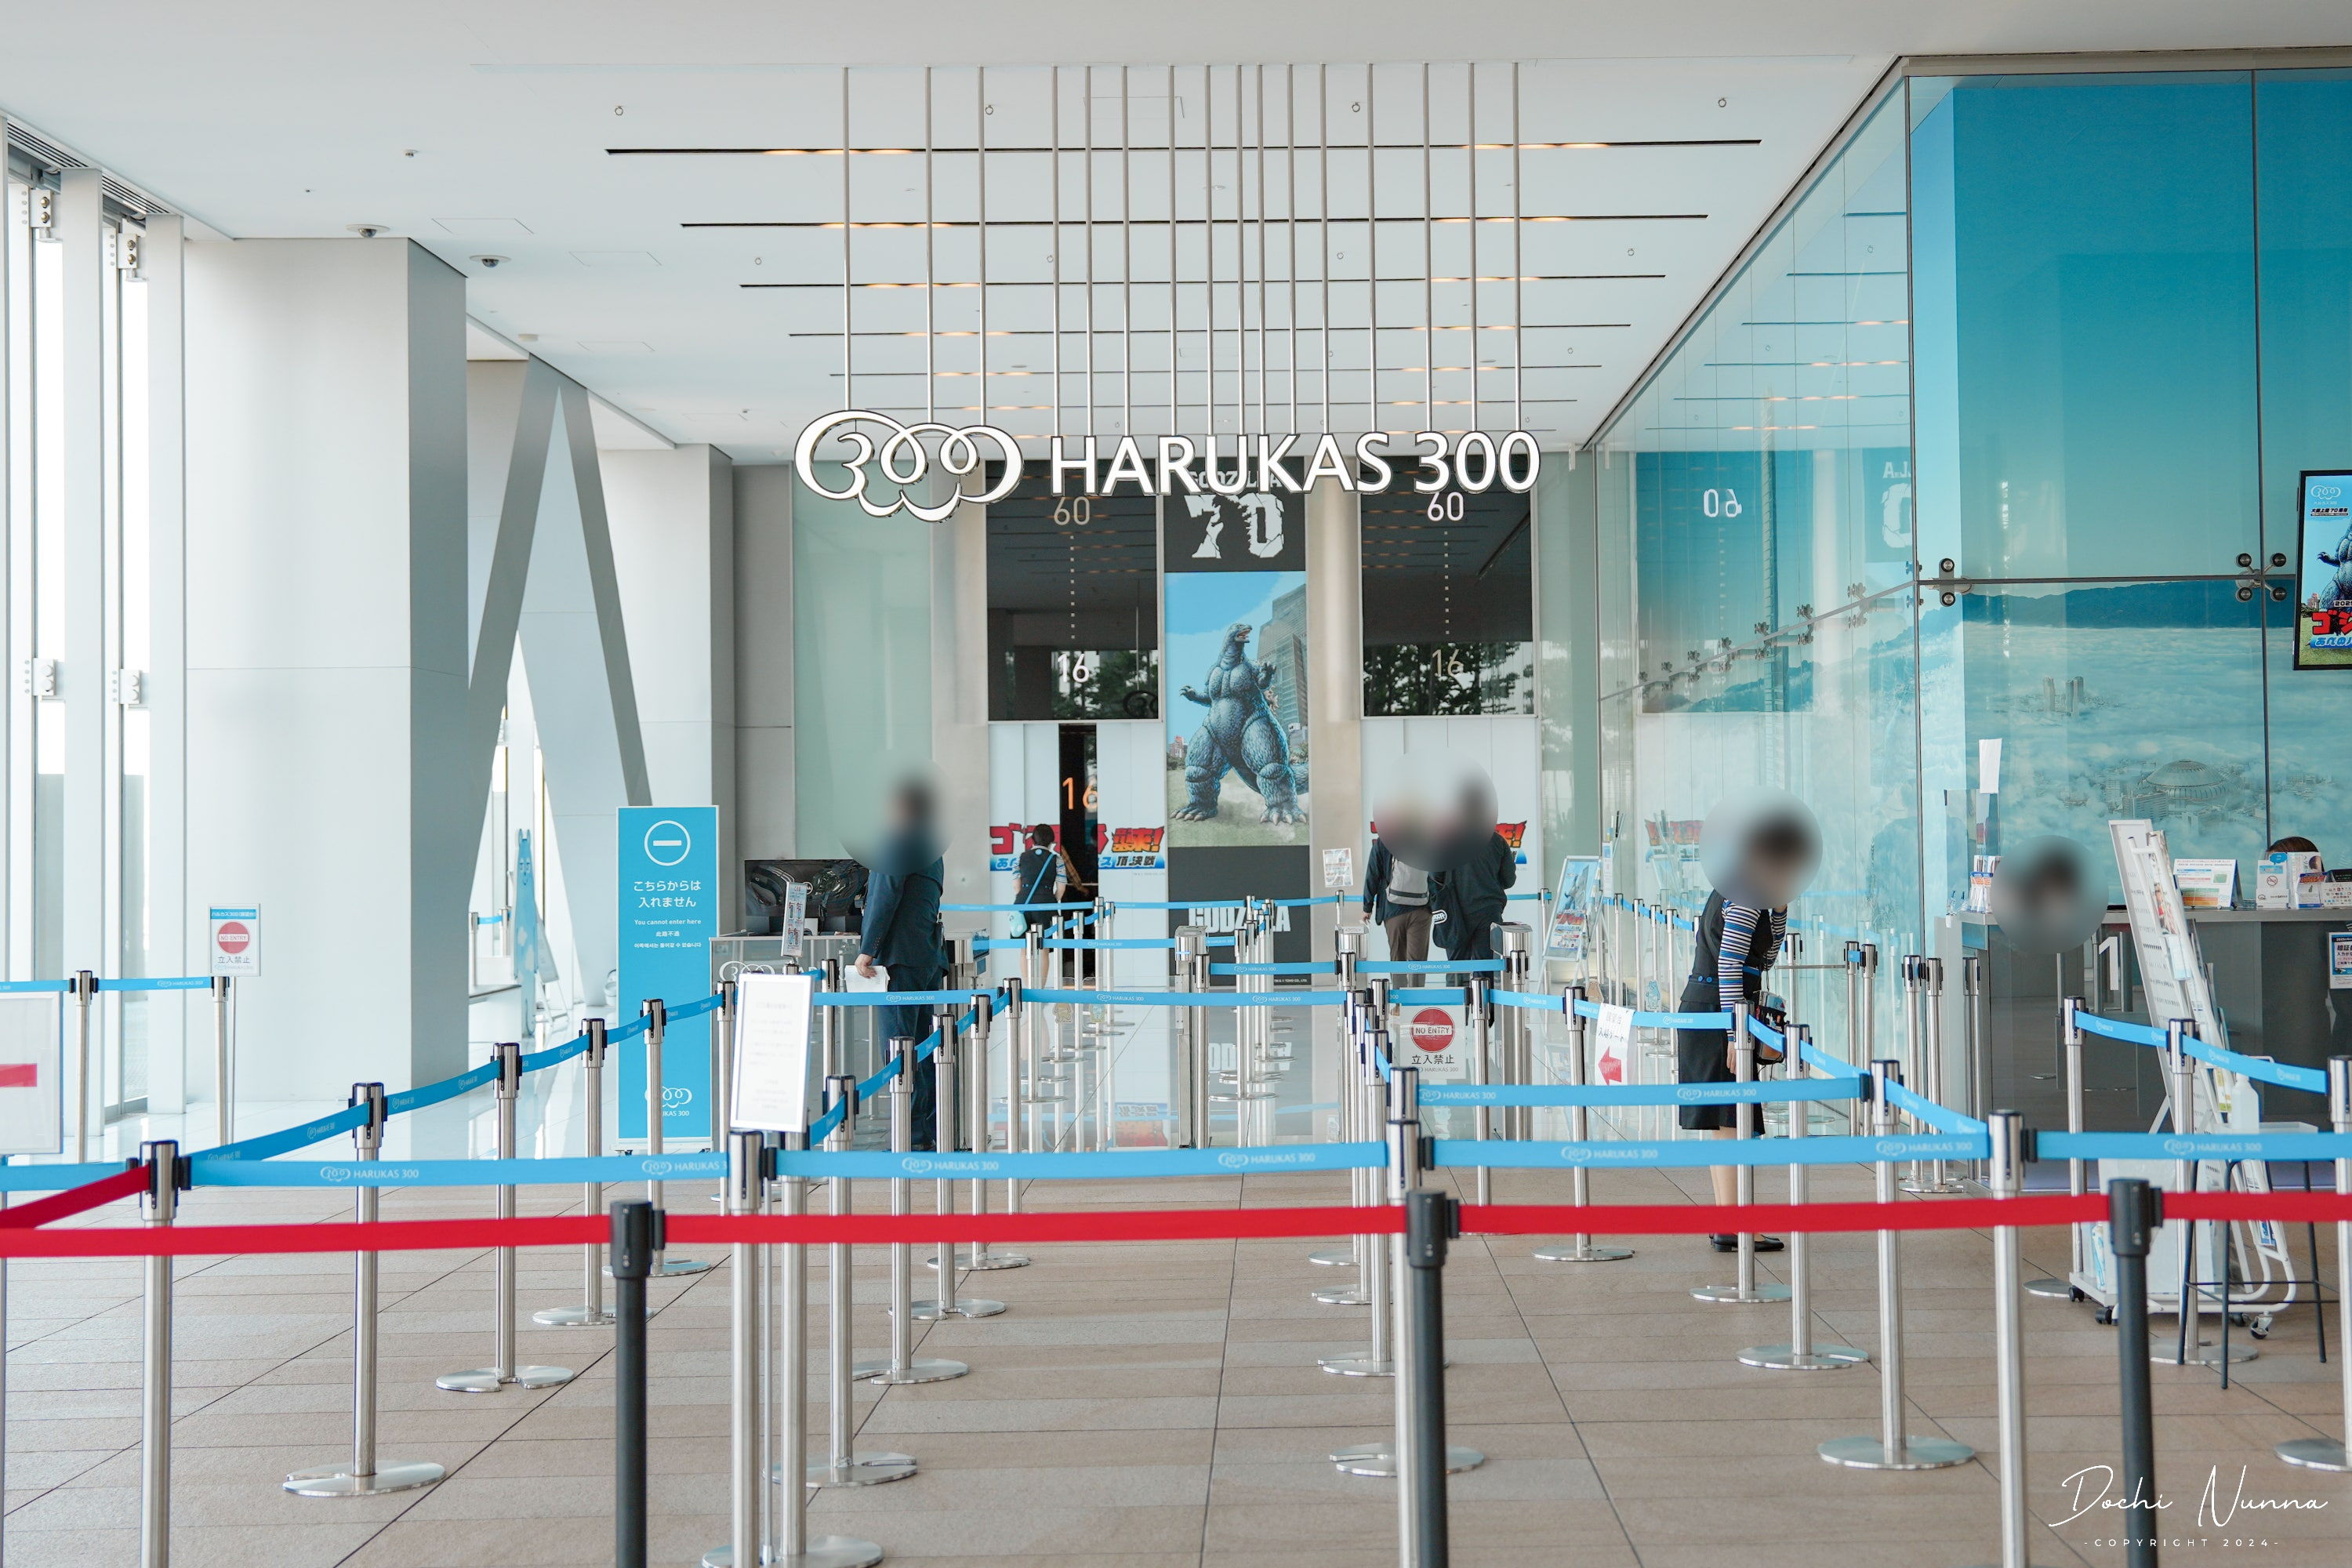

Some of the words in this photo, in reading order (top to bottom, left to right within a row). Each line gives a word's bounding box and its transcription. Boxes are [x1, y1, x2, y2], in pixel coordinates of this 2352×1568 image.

[1051, 433, 1392, 495] HARUKAS
[1414, 430, 1541, 494] 300
[1054, 496, 1091, 525] 60
[1427, 492, 1465, 521] 60
[1184, 493, 1285, 558] 70
[1057, 653, 1090, 683] 16
[1432, 648, 1464, 677] 16
[1062, 777, 1098, 810] 16
[633, 880, 702, 891] こちらからは
[638, 897, 697, 908] 入れません
[1411, 1054, 1454, 1065] 立入禁止
[1742, 1088, 1756, 1097] 300
[1908, 1142, 1952, 1152] HARUKAS
[1955, 1142, 1973, 1151] 300
[2197, 1142, 2242, 1152] HARUKAS
[2245, 1142, 2262, 1152] 300
[1250, 1154, 1295, 1163] HARUKAS
[1298, 1152, 1316, 1162] 300
[1593, 1149, 1638, 1159] HARUKAS
[1641, 1149, 1658, 1159] 300
[674, 1163, 720, 1172] HARUKAS
[935, 1162, 980, 1171] HARUKAS
[982, 1162, 999, 1171] 300
[354, 1170, 399, 1179] HARUKAS
[401, 1169, 419, 1178] 300
